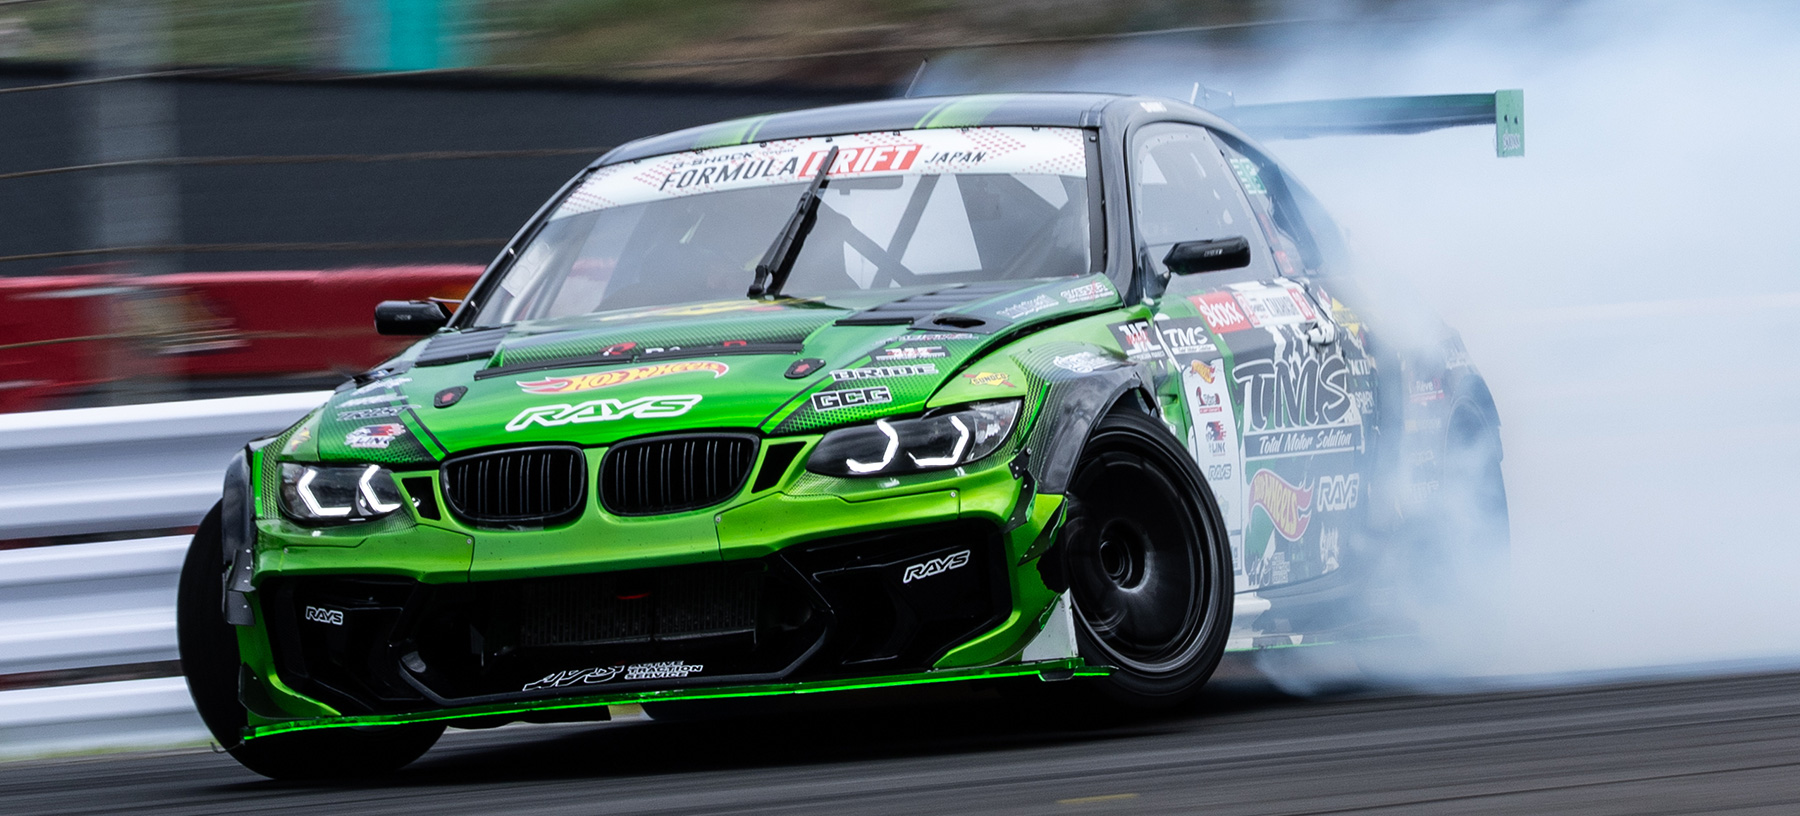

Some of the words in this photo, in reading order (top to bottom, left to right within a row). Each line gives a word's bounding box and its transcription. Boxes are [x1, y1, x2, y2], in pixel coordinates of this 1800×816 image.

[658, 156, 799, 192] FORMULA
[924, 151, 987, 165] JAPAN
[1163, 326, 1208, 347] TMS
[562, 371, 629, 391] HOT
[829, 363, 940, 382] BRIDE
[972, 373, 1010, 386] SUNOCO
[811, 386, 893, 412] GCG
[1232, 354, 1352, 431] TMS
[505, 394, 703, 431] RAYS
[1259, 433, 1284, 454] Total
[1284, 431, 1313, 452] Motor
[1316, 429, 1352, 448] Solution
[1208, 463, 1232, 480] RAYS
[1264, 473, 1299, 536] WHEELS
[1317, 473, 1360, 513] RAYS
[903, 549, 971, 584] RAYS
[305, 605, 344, 626] RAYS
[627, 665, 704, 674] TRACTION
